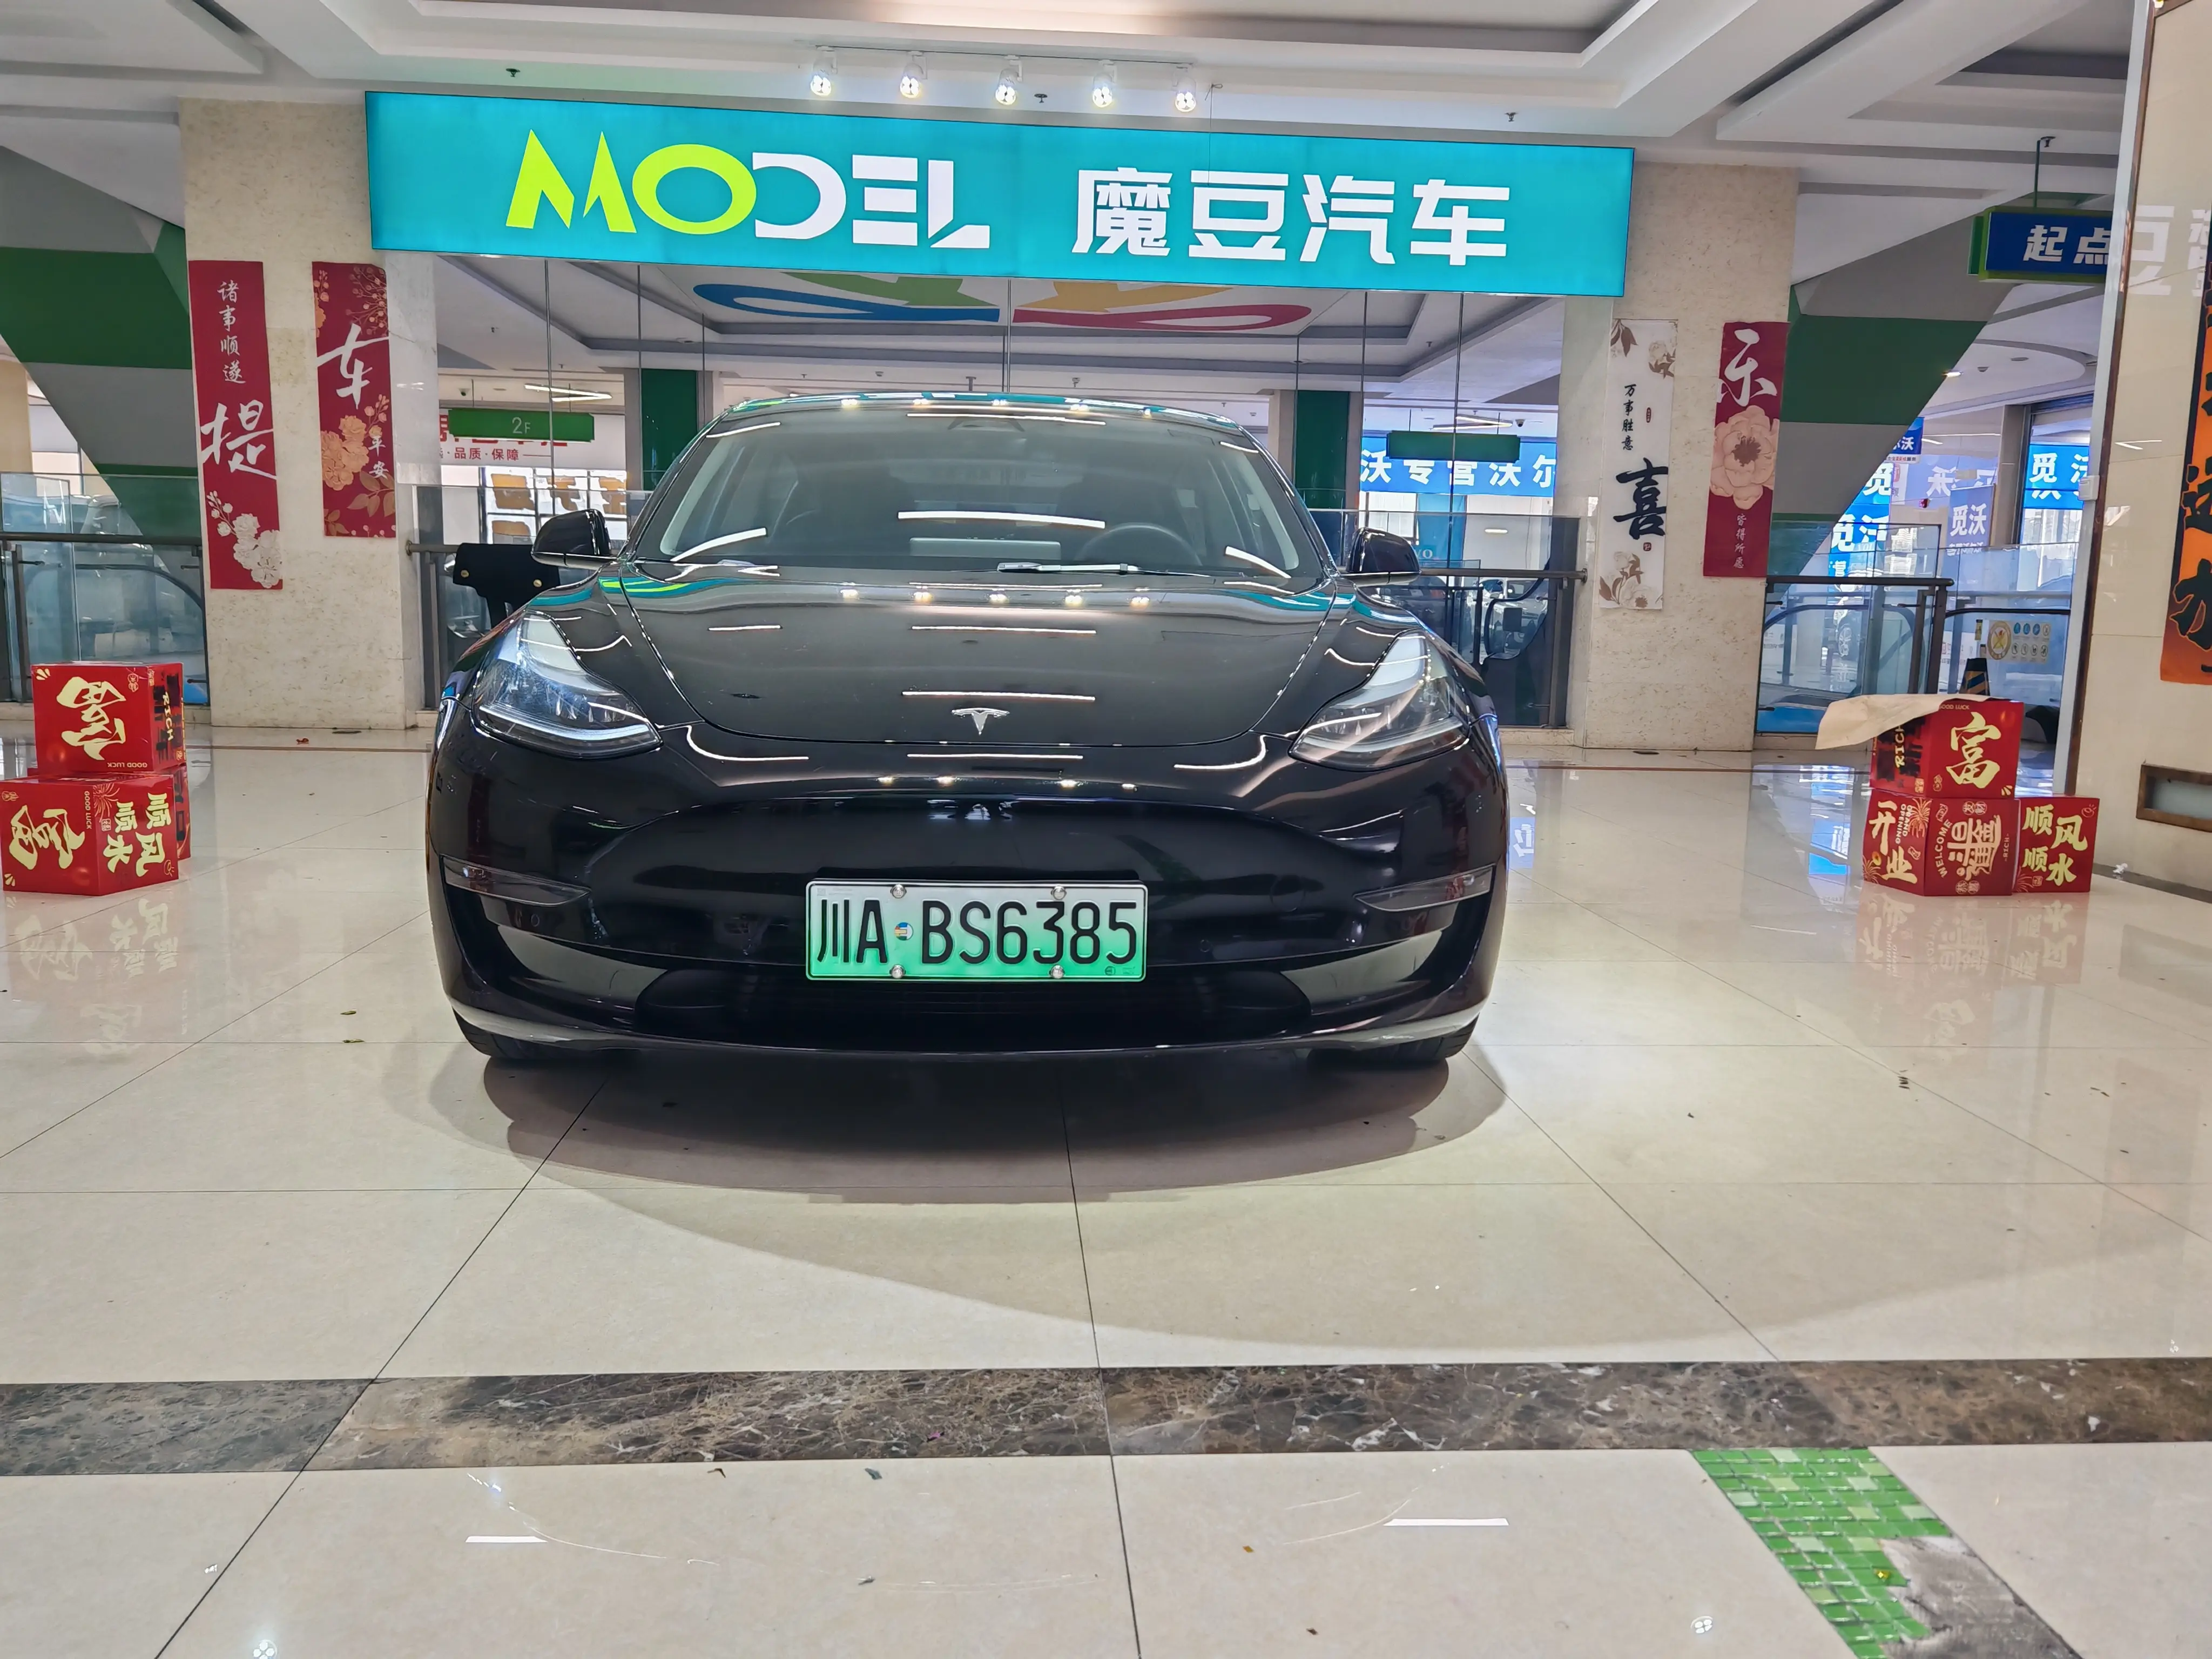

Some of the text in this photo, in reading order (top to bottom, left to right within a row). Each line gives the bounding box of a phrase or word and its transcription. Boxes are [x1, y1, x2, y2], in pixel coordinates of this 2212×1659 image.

[506, 129, 990, 248] MODEL
[1071, 167, 1510, 266] 魔豆汽车
[2023, 224, 2112, 265] 起点
[217, 280, 246, 383] 诸事顺遂
[316, 323, 389, 409] 车
[1716, 329, 1777, 407] 乐
[200, 400, 276, 480] 提
[512, 417, 531, 434] 2F
[1621, 384, 1636, 450] 万事胜意
[1893, 436, 1914, 450] 沃
[1613, 457, 1669, 540] 喜
[1950, 503, 1987, 537] 觅沃
[1733, 514, 1746, 569] 皆得所愿
[56, 676, 126, 760] 富
[163, 692, 173, 741] RICH
[1946, 711, 2001, 788] 富
[9, 805, 85, 870] 富
[1869, 800, 1918, 885] 开业
[1934, 819, 1953, 879] WELCOME
[922, 900, 1137, 965] BS6385
